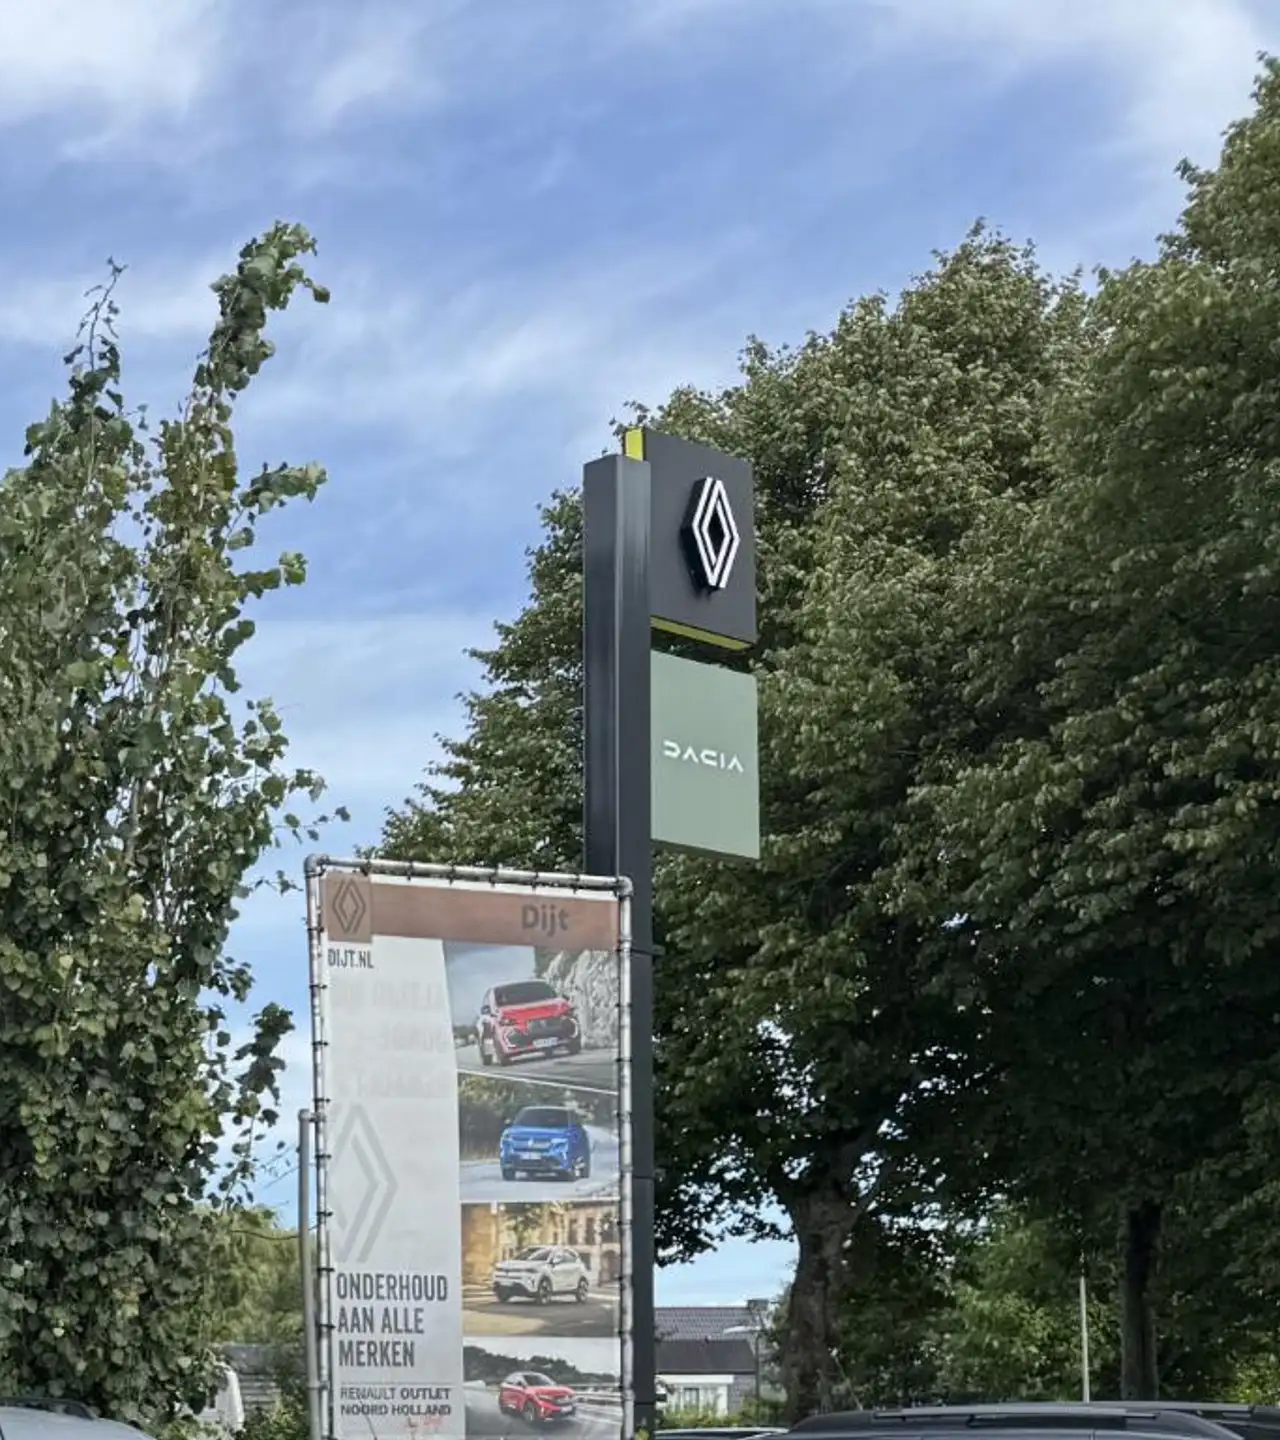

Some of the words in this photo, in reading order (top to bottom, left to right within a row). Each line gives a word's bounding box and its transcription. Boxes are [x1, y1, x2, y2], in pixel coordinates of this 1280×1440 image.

[662, 741, 744, 773] DACIA
[521, 904, 569, 937] Dijt
[327, 948, 374, 968] DIJT.NL
[337, 1273, 448, 1301] ONDERHOUD
[338, 1306, 374, 1333] AAN
[381, 1307, 425, 1334] ALLE
[339, 1339, 415, 1367] MERKEN
[340, 1386, 396, 1400] RENAULT
[400, 1387, 452, 1400] OUTLET
[341, 1404, 389, 1416] NOORD
[391, 1404, 452, 1416] HOLLAND
